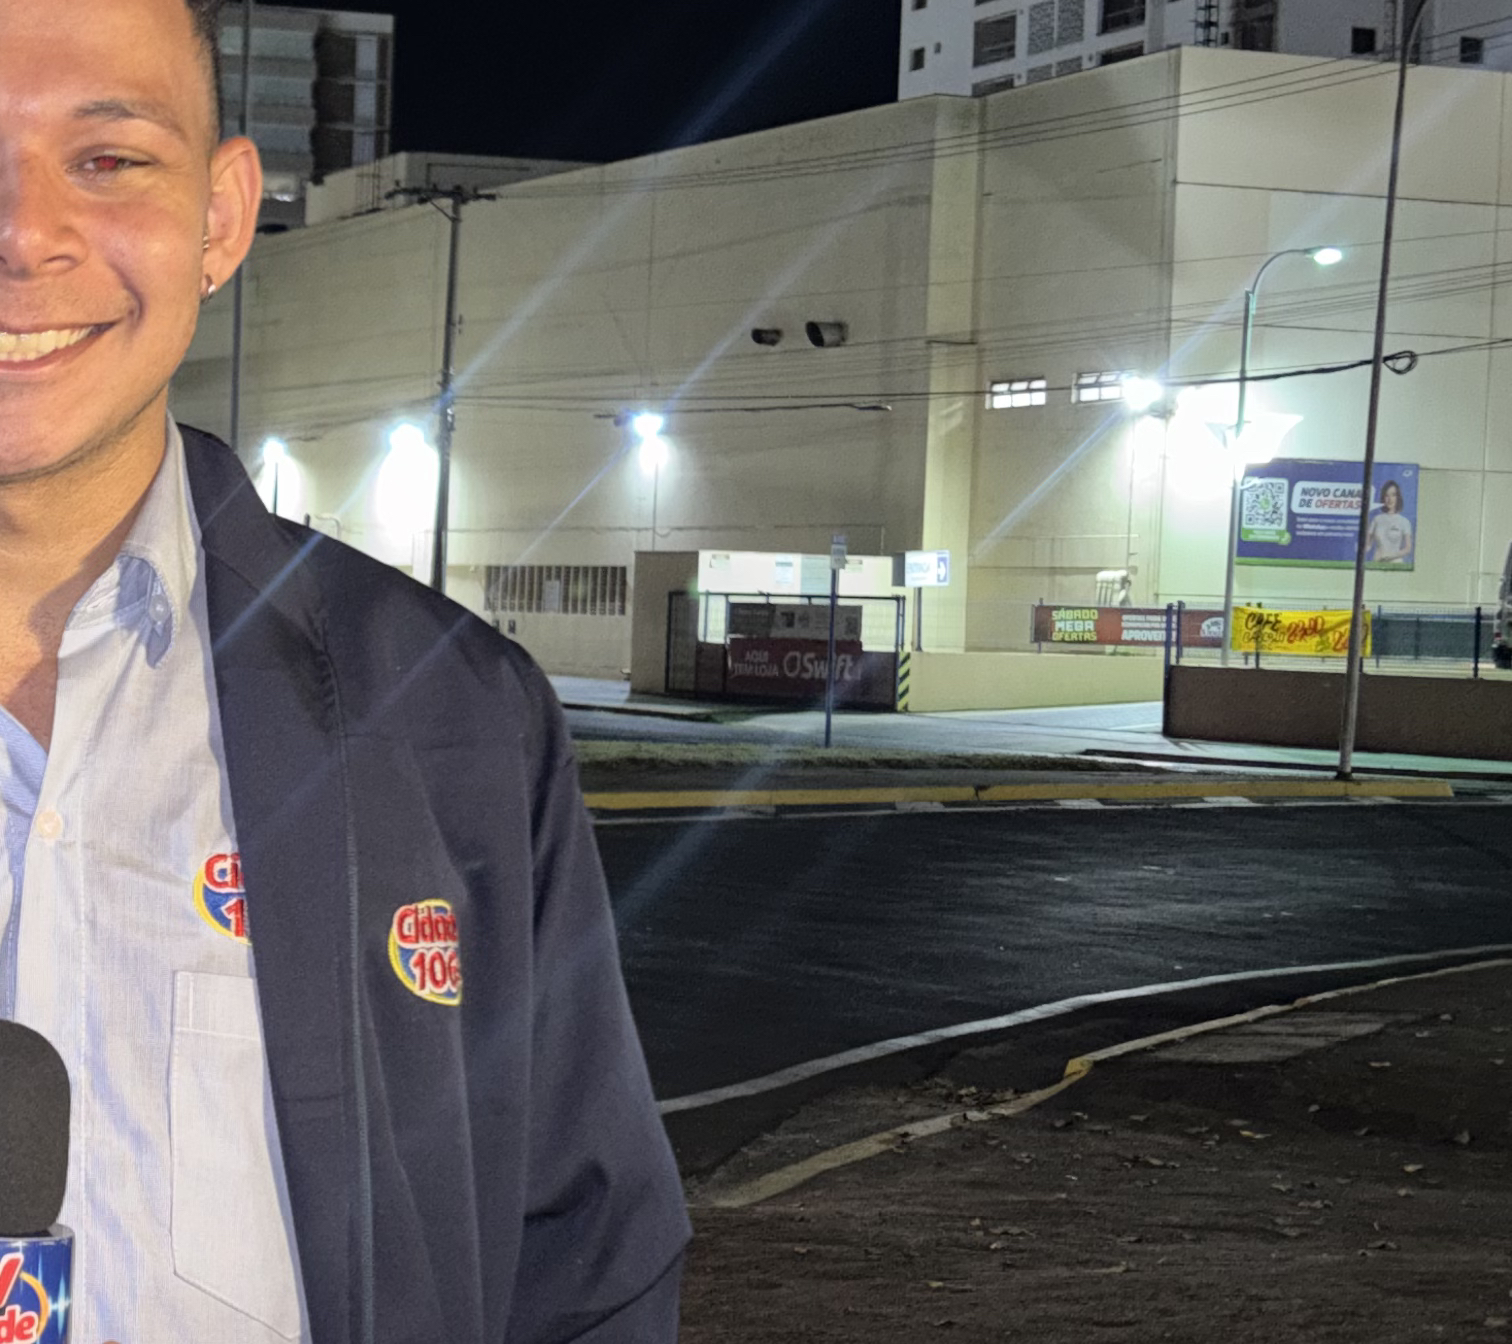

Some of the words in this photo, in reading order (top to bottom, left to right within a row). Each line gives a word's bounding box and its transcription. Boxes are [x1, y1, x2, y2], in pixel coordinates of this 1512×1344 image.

[1300, 487, 1331, 498] NOVO
[1332, 488, 1364, 499] CANA
[1298, 499, 1313, 508] DE
[1052, 608, 1098, 620] SÁBADO
[1055, 620, 1095, 631] MEGA
[1052, 631, 1097, 642] OFERTAS
[745, 650, 769, 662] AQUI
[801, 652, 855, 680] Swft
